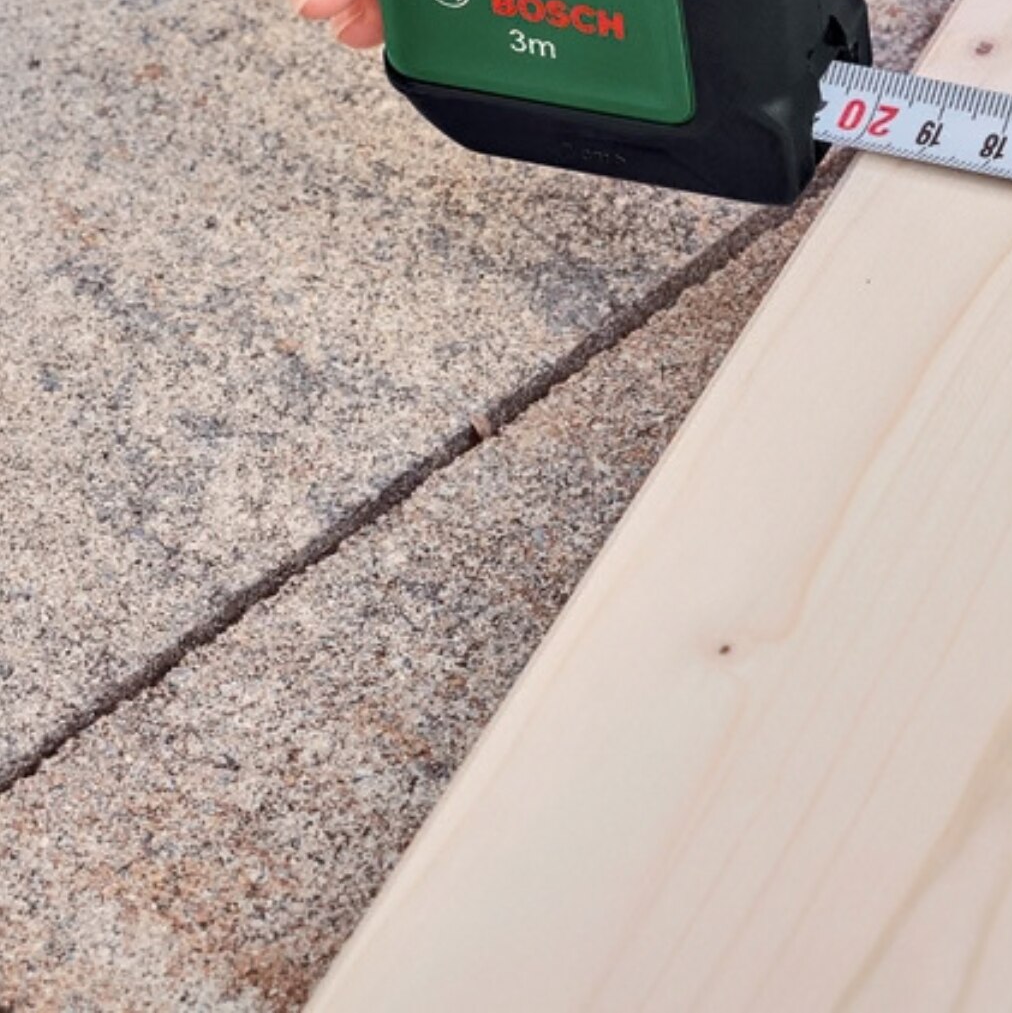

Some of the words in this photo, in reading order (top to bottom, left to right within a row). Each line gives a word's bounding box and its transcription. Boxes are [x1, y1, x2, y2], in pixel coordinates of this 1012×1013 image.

[509, 29, 557, 59] 3m
[837, 99, 900, 136] 20
[915, 120, 944, 146] 19
[979, 134, 1008, 159] 18
